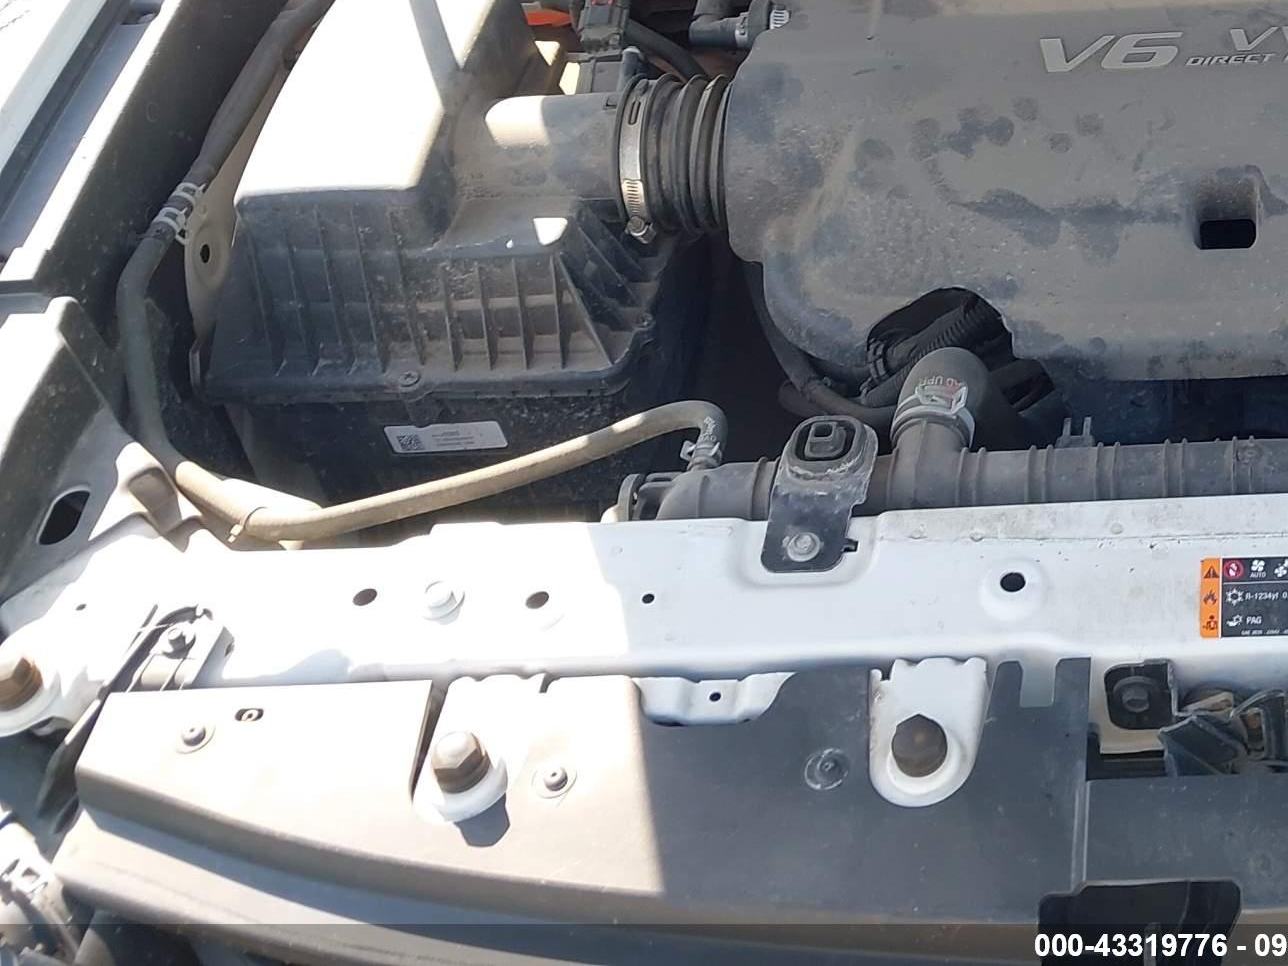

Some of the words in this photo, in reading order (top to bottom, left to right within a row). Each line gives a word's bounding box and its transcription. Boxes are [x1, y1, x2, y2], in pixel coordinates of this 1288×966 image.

[1039, 31, 1185, 73] V6
[1184, 52, 1273, 68] DIRECT
[1249, 571, 1267, 579] AUTO
[1246, 615, 1262, 625] PAG
